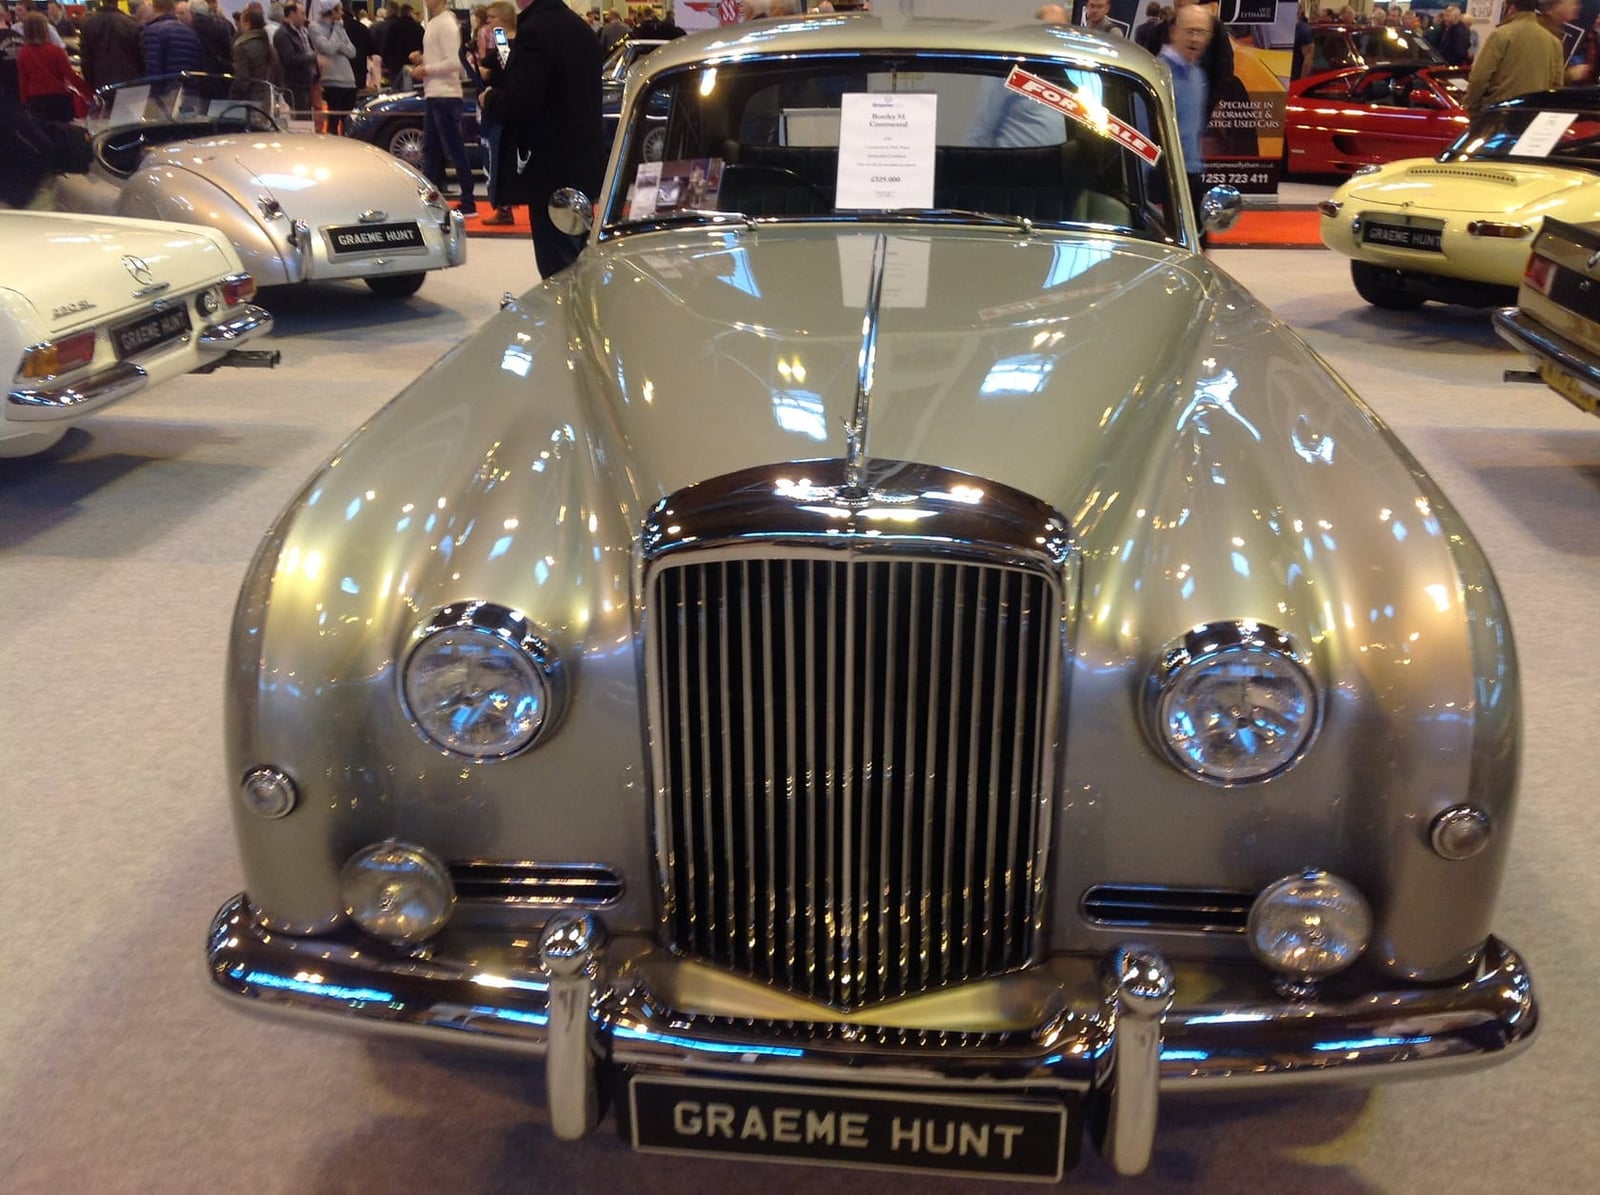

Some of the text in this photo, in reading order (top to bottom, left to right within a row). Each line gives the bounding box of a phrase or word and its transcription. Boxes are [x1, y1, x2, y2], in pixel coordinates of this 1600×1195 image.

[1218, 100, 1274, 110] SPECIALISE IN
[1021, 79, 1148, 151] FOR ALE
[1208, 119, 1280, 129] STIGE USED CARS
[1212, 111, 1273, 119] RFORMANCE &
[1201, 172, 1269, 184] 1253 723 411
[338, 229, 416, 248] GRAEME HUNT
[1368, 228, 1442, 248] GRAEME HUNT
[121, 311, 185, 351] GRAEME HUNT
[672, 1100, 1025, 1160] GRAEME HUNT
